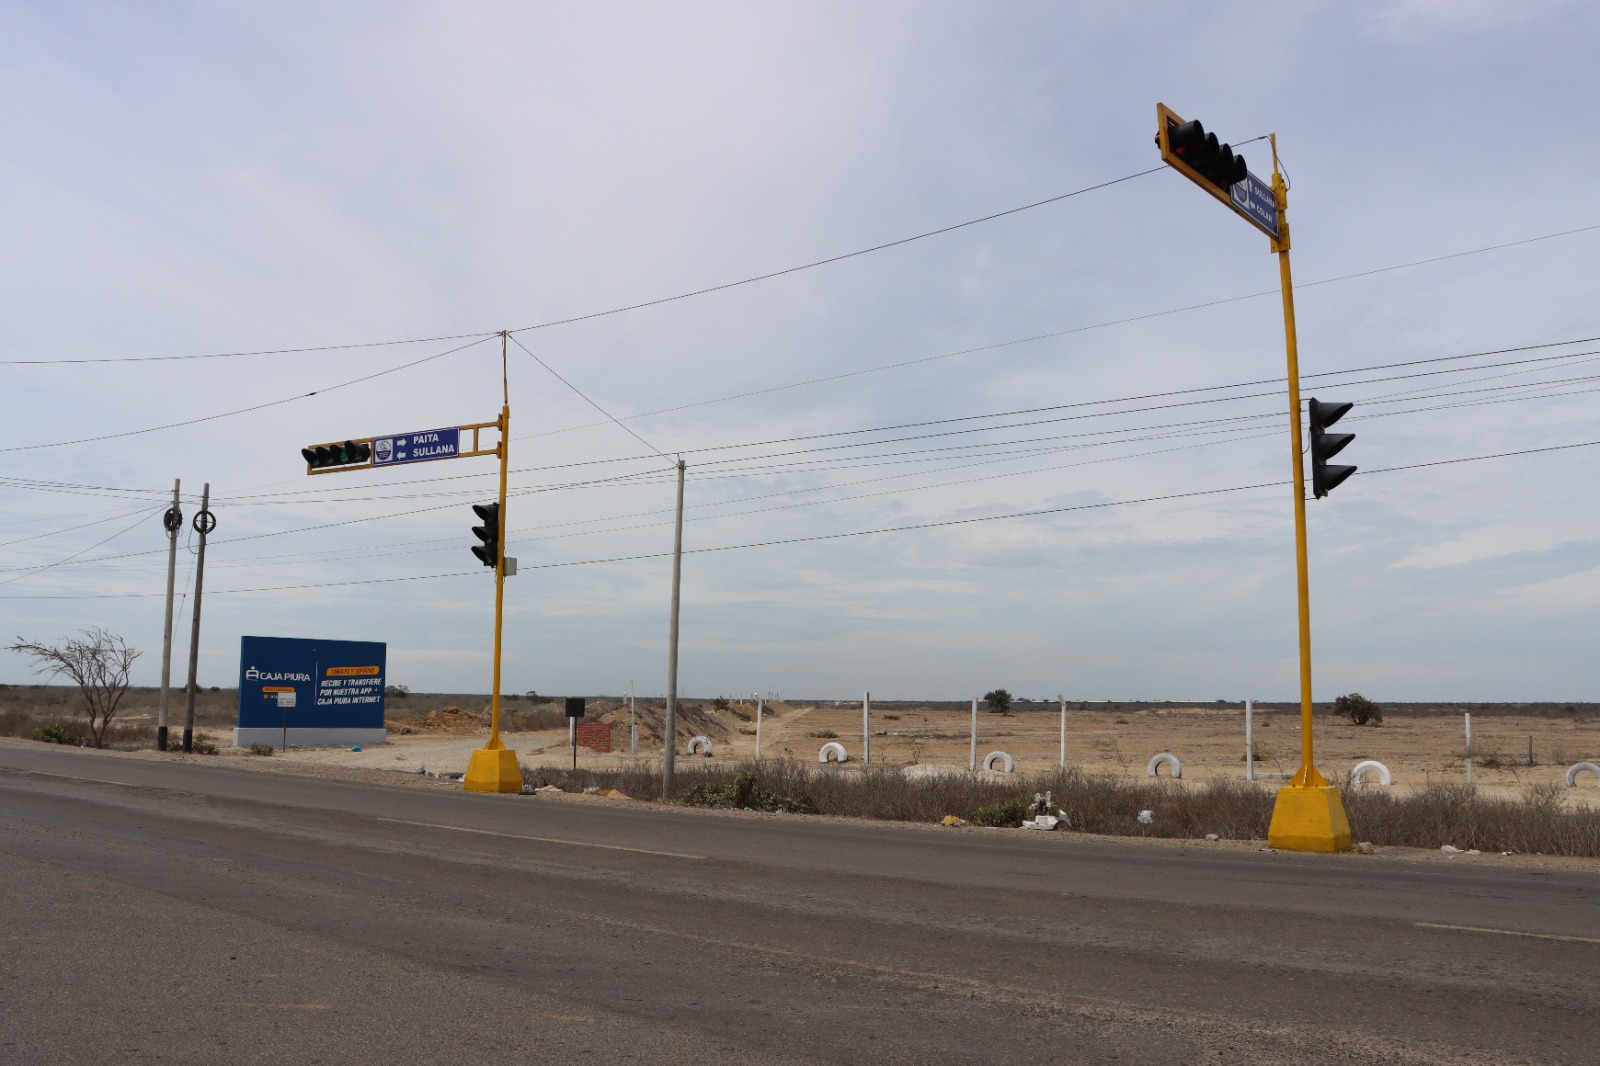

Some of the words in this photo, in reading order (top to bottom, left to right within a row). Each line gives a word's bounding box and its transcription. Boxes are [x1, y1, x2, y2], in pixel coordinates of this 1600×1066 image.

[413, 434, 439, 444] PAITA
[413, 445, 454, 457] SULLANA
[284, 673, 310, 681] PIURA
[347, 678, 382, 686] TRANSFIERE
[333, 688, 360, 696] NUESTRA
